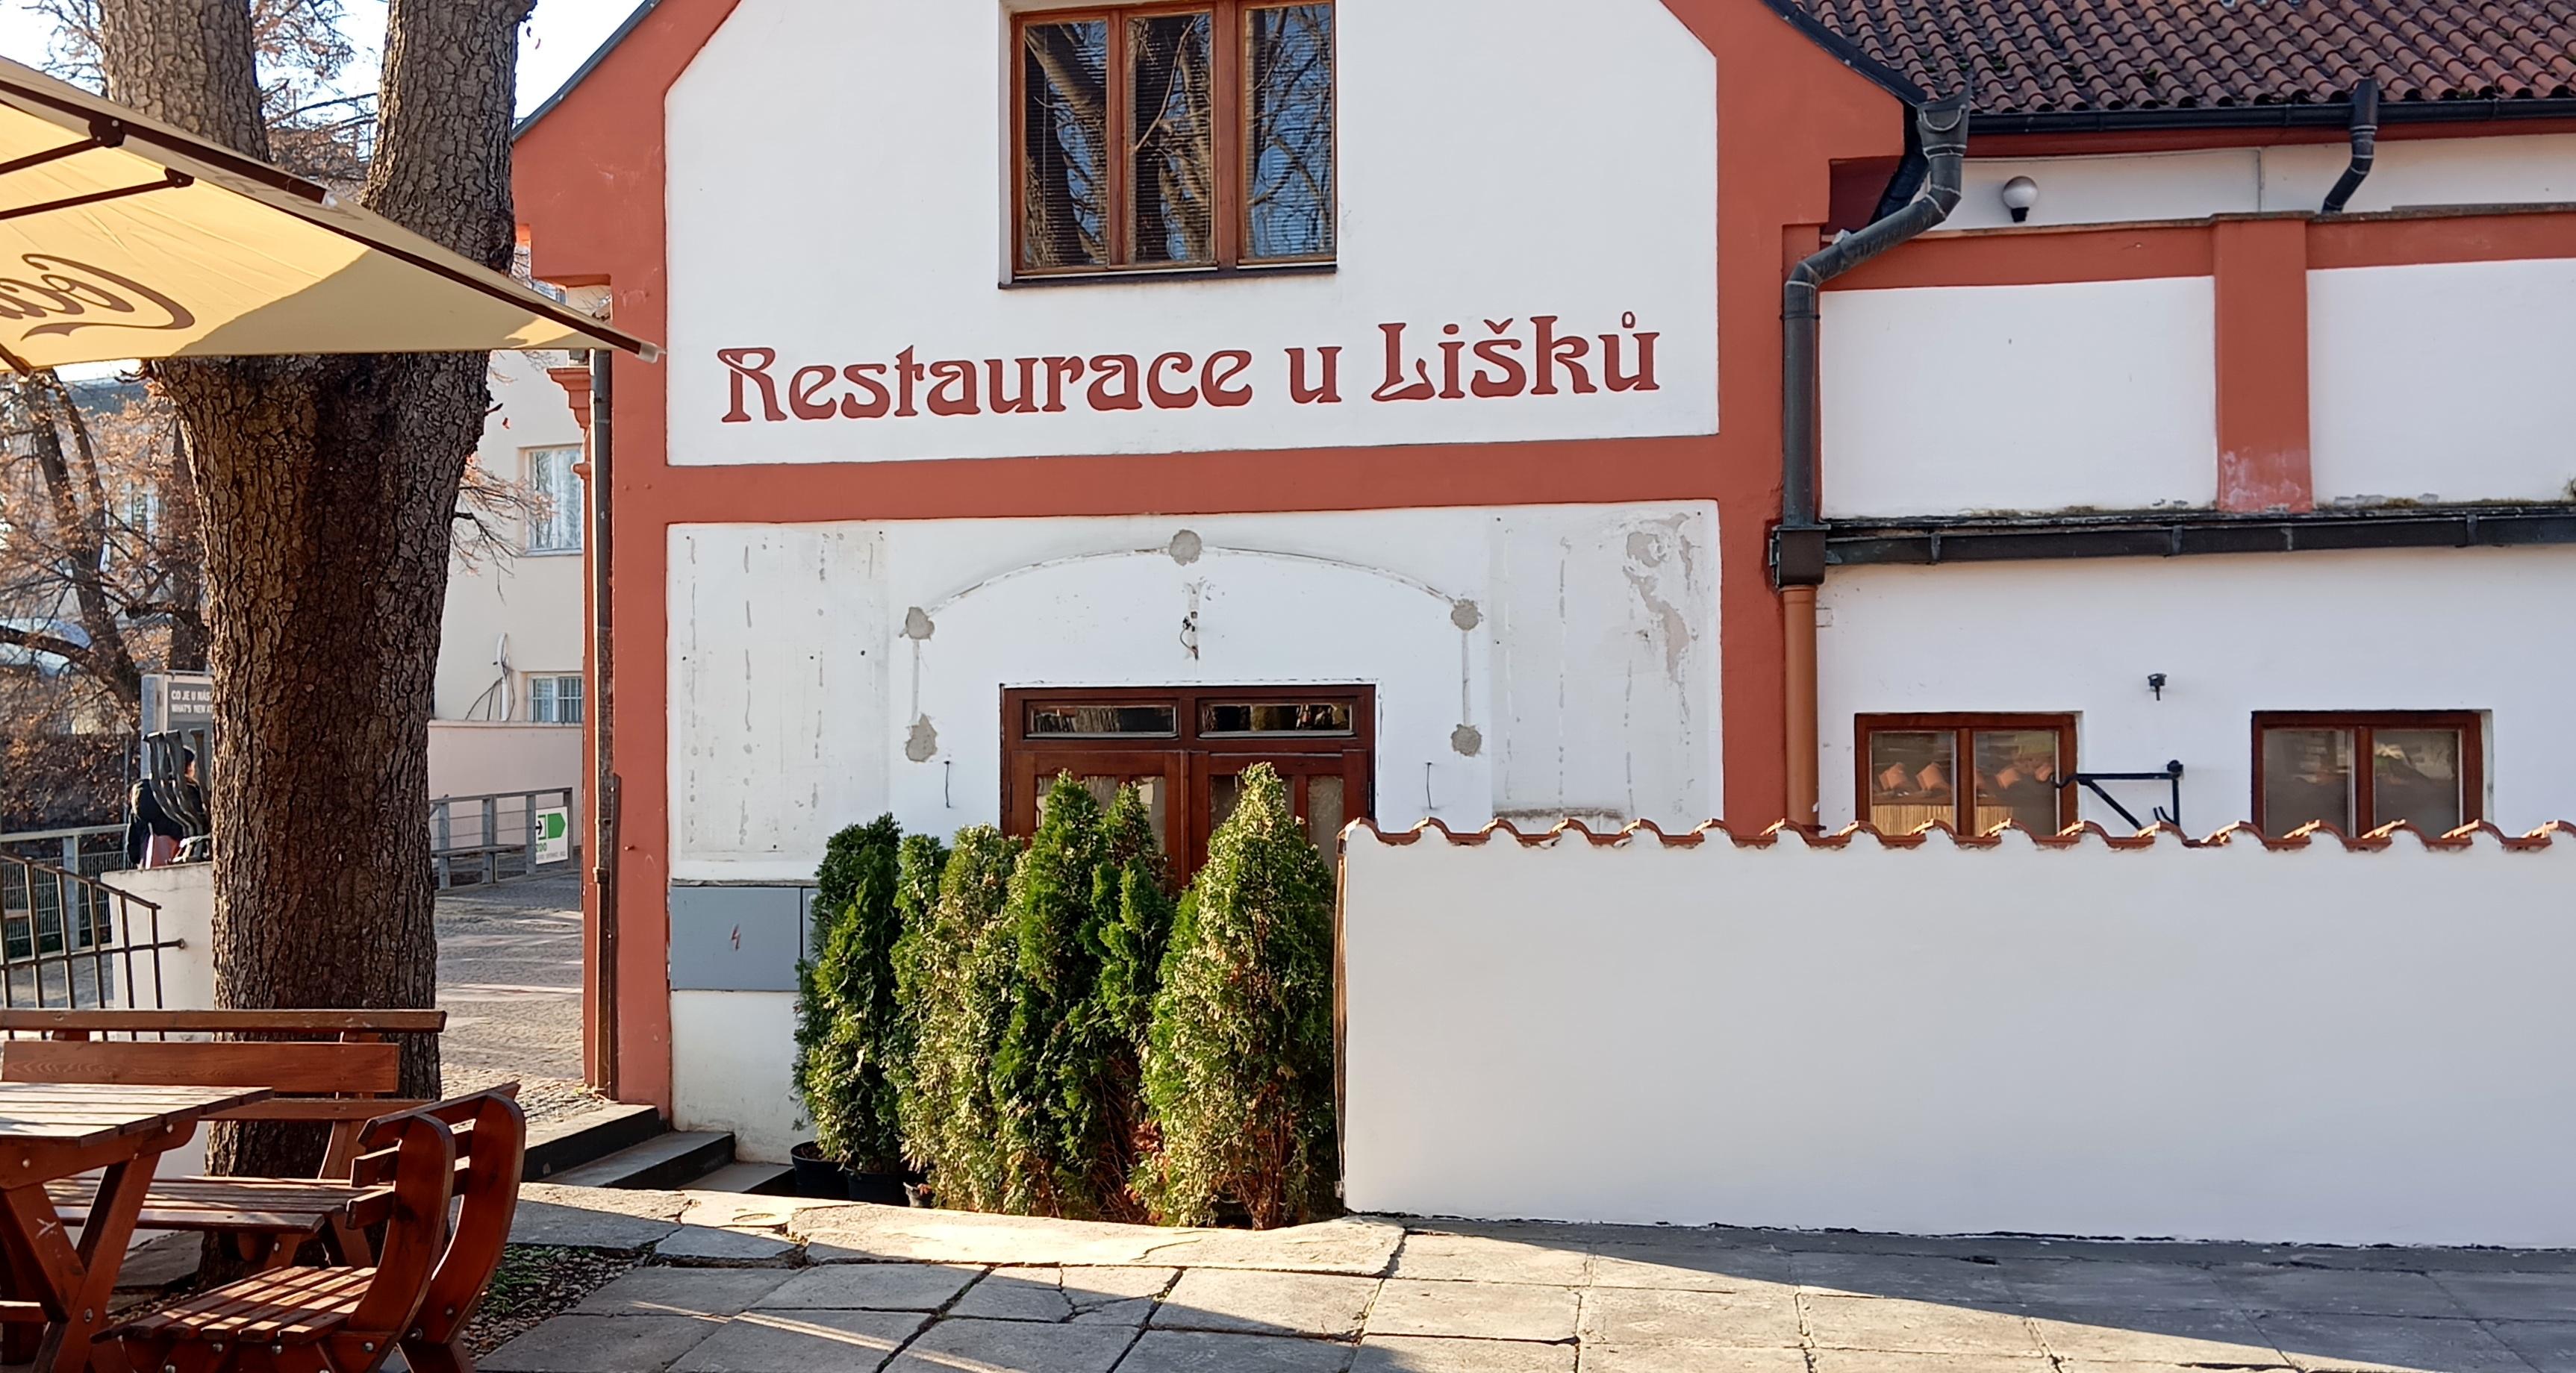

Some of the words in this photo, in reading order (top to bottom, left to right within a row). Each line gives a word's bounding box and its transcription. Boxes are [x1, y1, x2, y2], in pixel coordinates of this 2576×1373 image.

[717, 345, 1254, 423] Restaurace
[1284, 346, 1342, 404] u
[1370, 310, 1660, 403] Lišků
[171, 690, 181, 700] CO
[182, 690, 190, 701] JE
[191, 691, 196, 701] U
